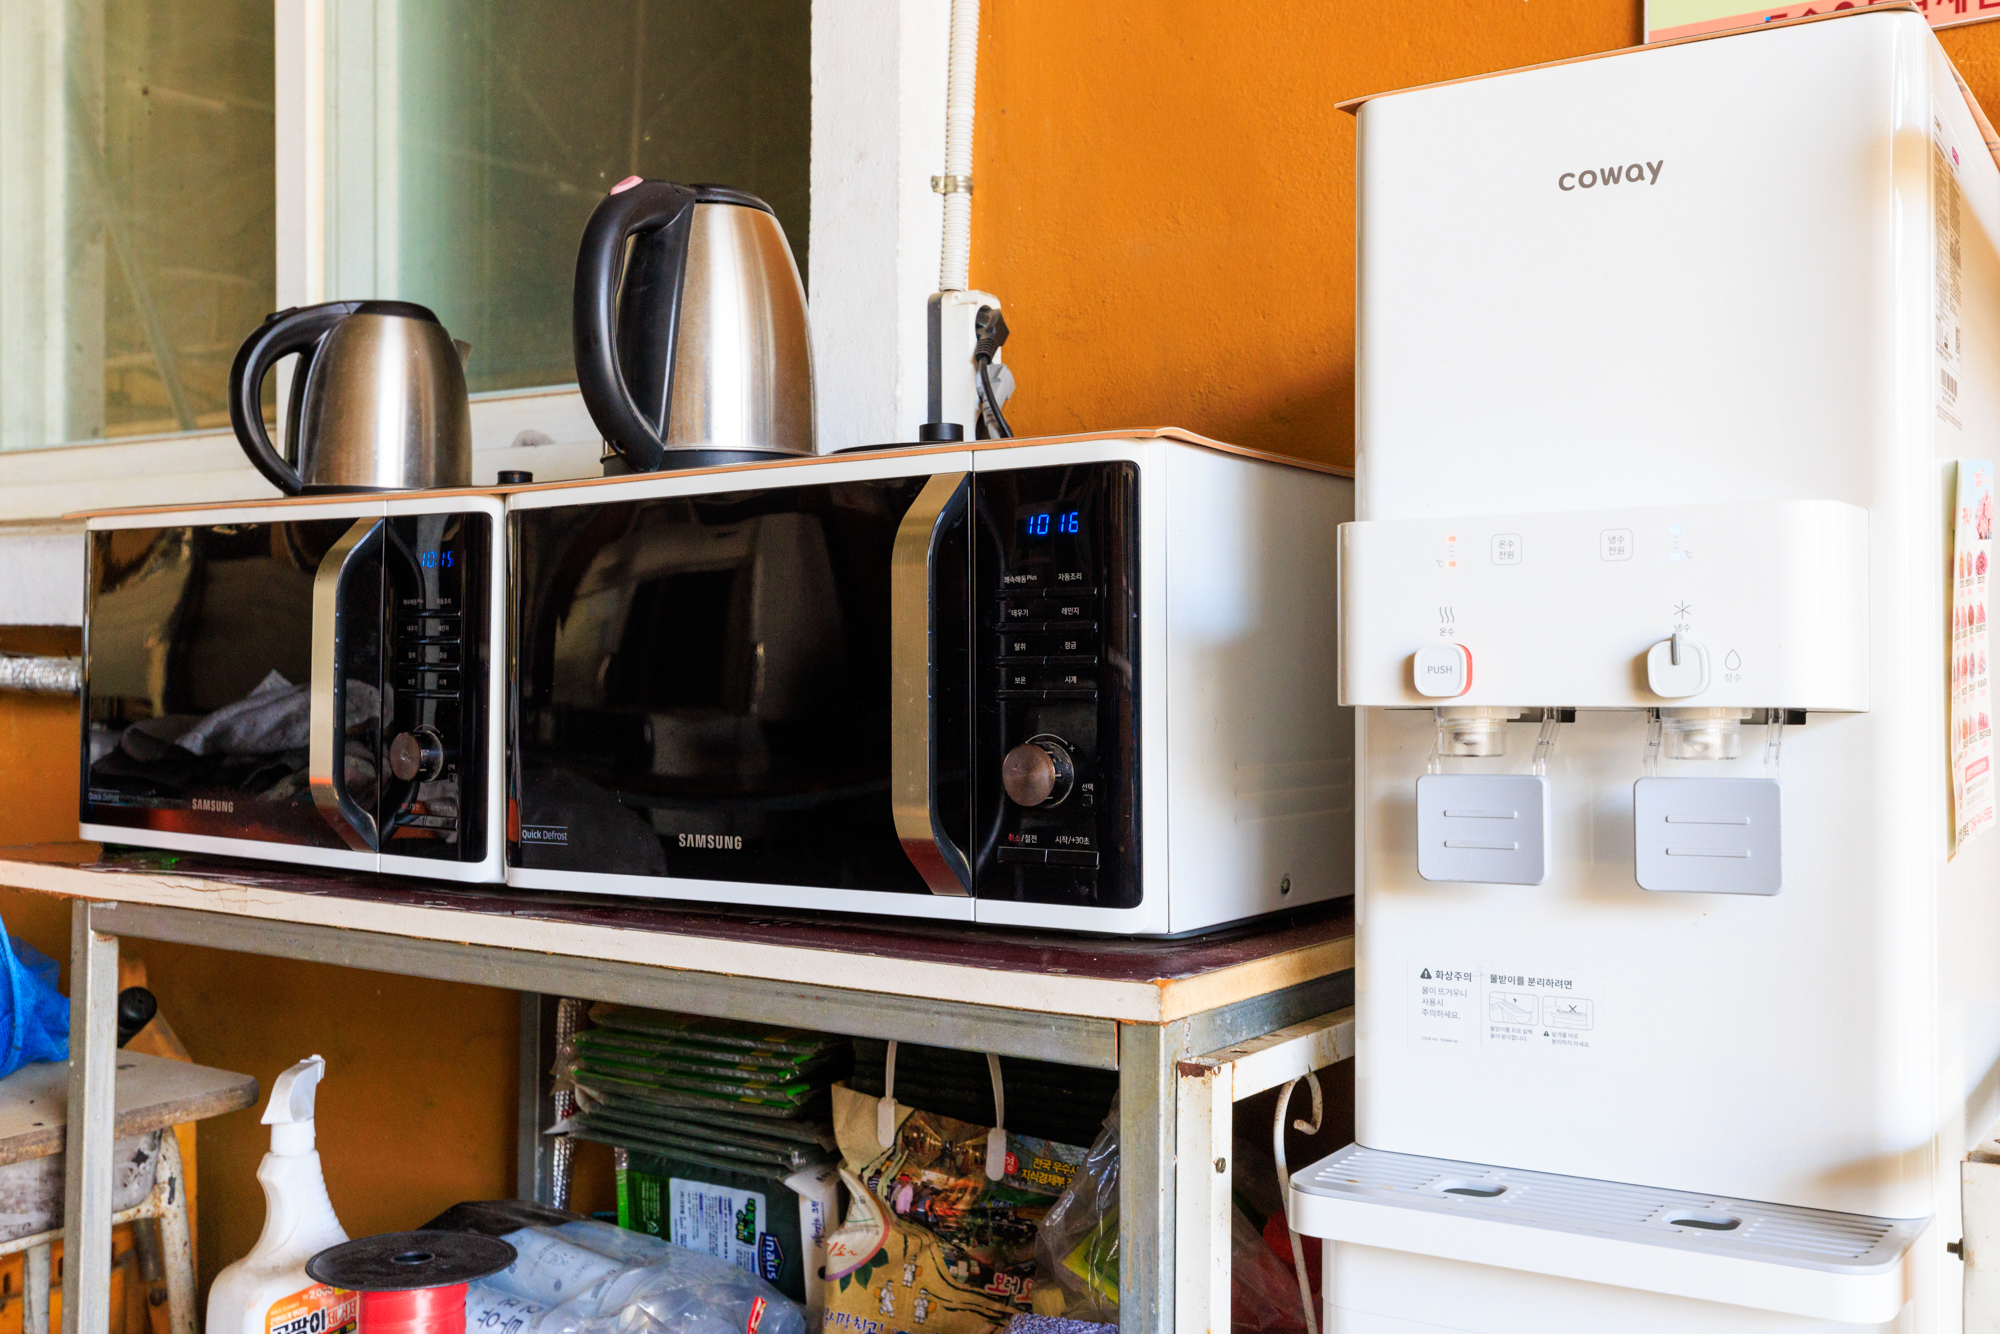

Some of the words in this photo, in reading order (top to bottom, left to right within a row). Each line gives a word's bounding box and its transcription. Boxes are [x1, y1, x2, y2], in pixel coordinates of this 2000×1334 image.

[1558, 159, 1664, 191] coway
[1498, 540, 1514, 549] 온수
[1607, 535, 1625, 545] 냉수
[1498, 551, 1515, 560] 전원
[1608, 546, 1625, 556] 전원
[1058, 572, 1083, 581] 자동조리
[1010, 609, 1029, 617] 데우기
[1061, 607, 1080, 616] 레인지
[1439, 627, 1455, 637] 온수
[1014, 642, 1026, 651] 탈취
[1064, 641, 1077, 650] 잠금
[1427, 665, 1453, 675] PUSH
[1014, 676, 1026, 684] 보온
[1065, 675, 1077, 684] 시계
[1724, 673, 1742, 683] 정수
[1081, 783, 1094, 792] 선택
[192, 798, 234, 813] SAMSUNG
[521, 829, 541, 840] Quick
[542, 830, 567, 841] Defrost
[1008, 833, 1037, 844] 취소/절전
[678, 833, 742, 850] SAMSUNG
[1435, 969, 1472, 983] 화상주의
[1490, 973, 1525, 986] 물받이를
[1527, 976, 1573, 990] 분리하려면
[1421, 986, 1436, 996] 물이
[1438, 987, 1468, 998] 뜨거우니
[1421, 997, 1444, 1007] 사용시
[1421, 1008, 1461, 1020] 주의하세요.
[1033, 1157, 1051, 1171] 전국
[1021, 1169, 1065, 1187] 지식경제부
[765, 1235, 777, 1280] inaus
